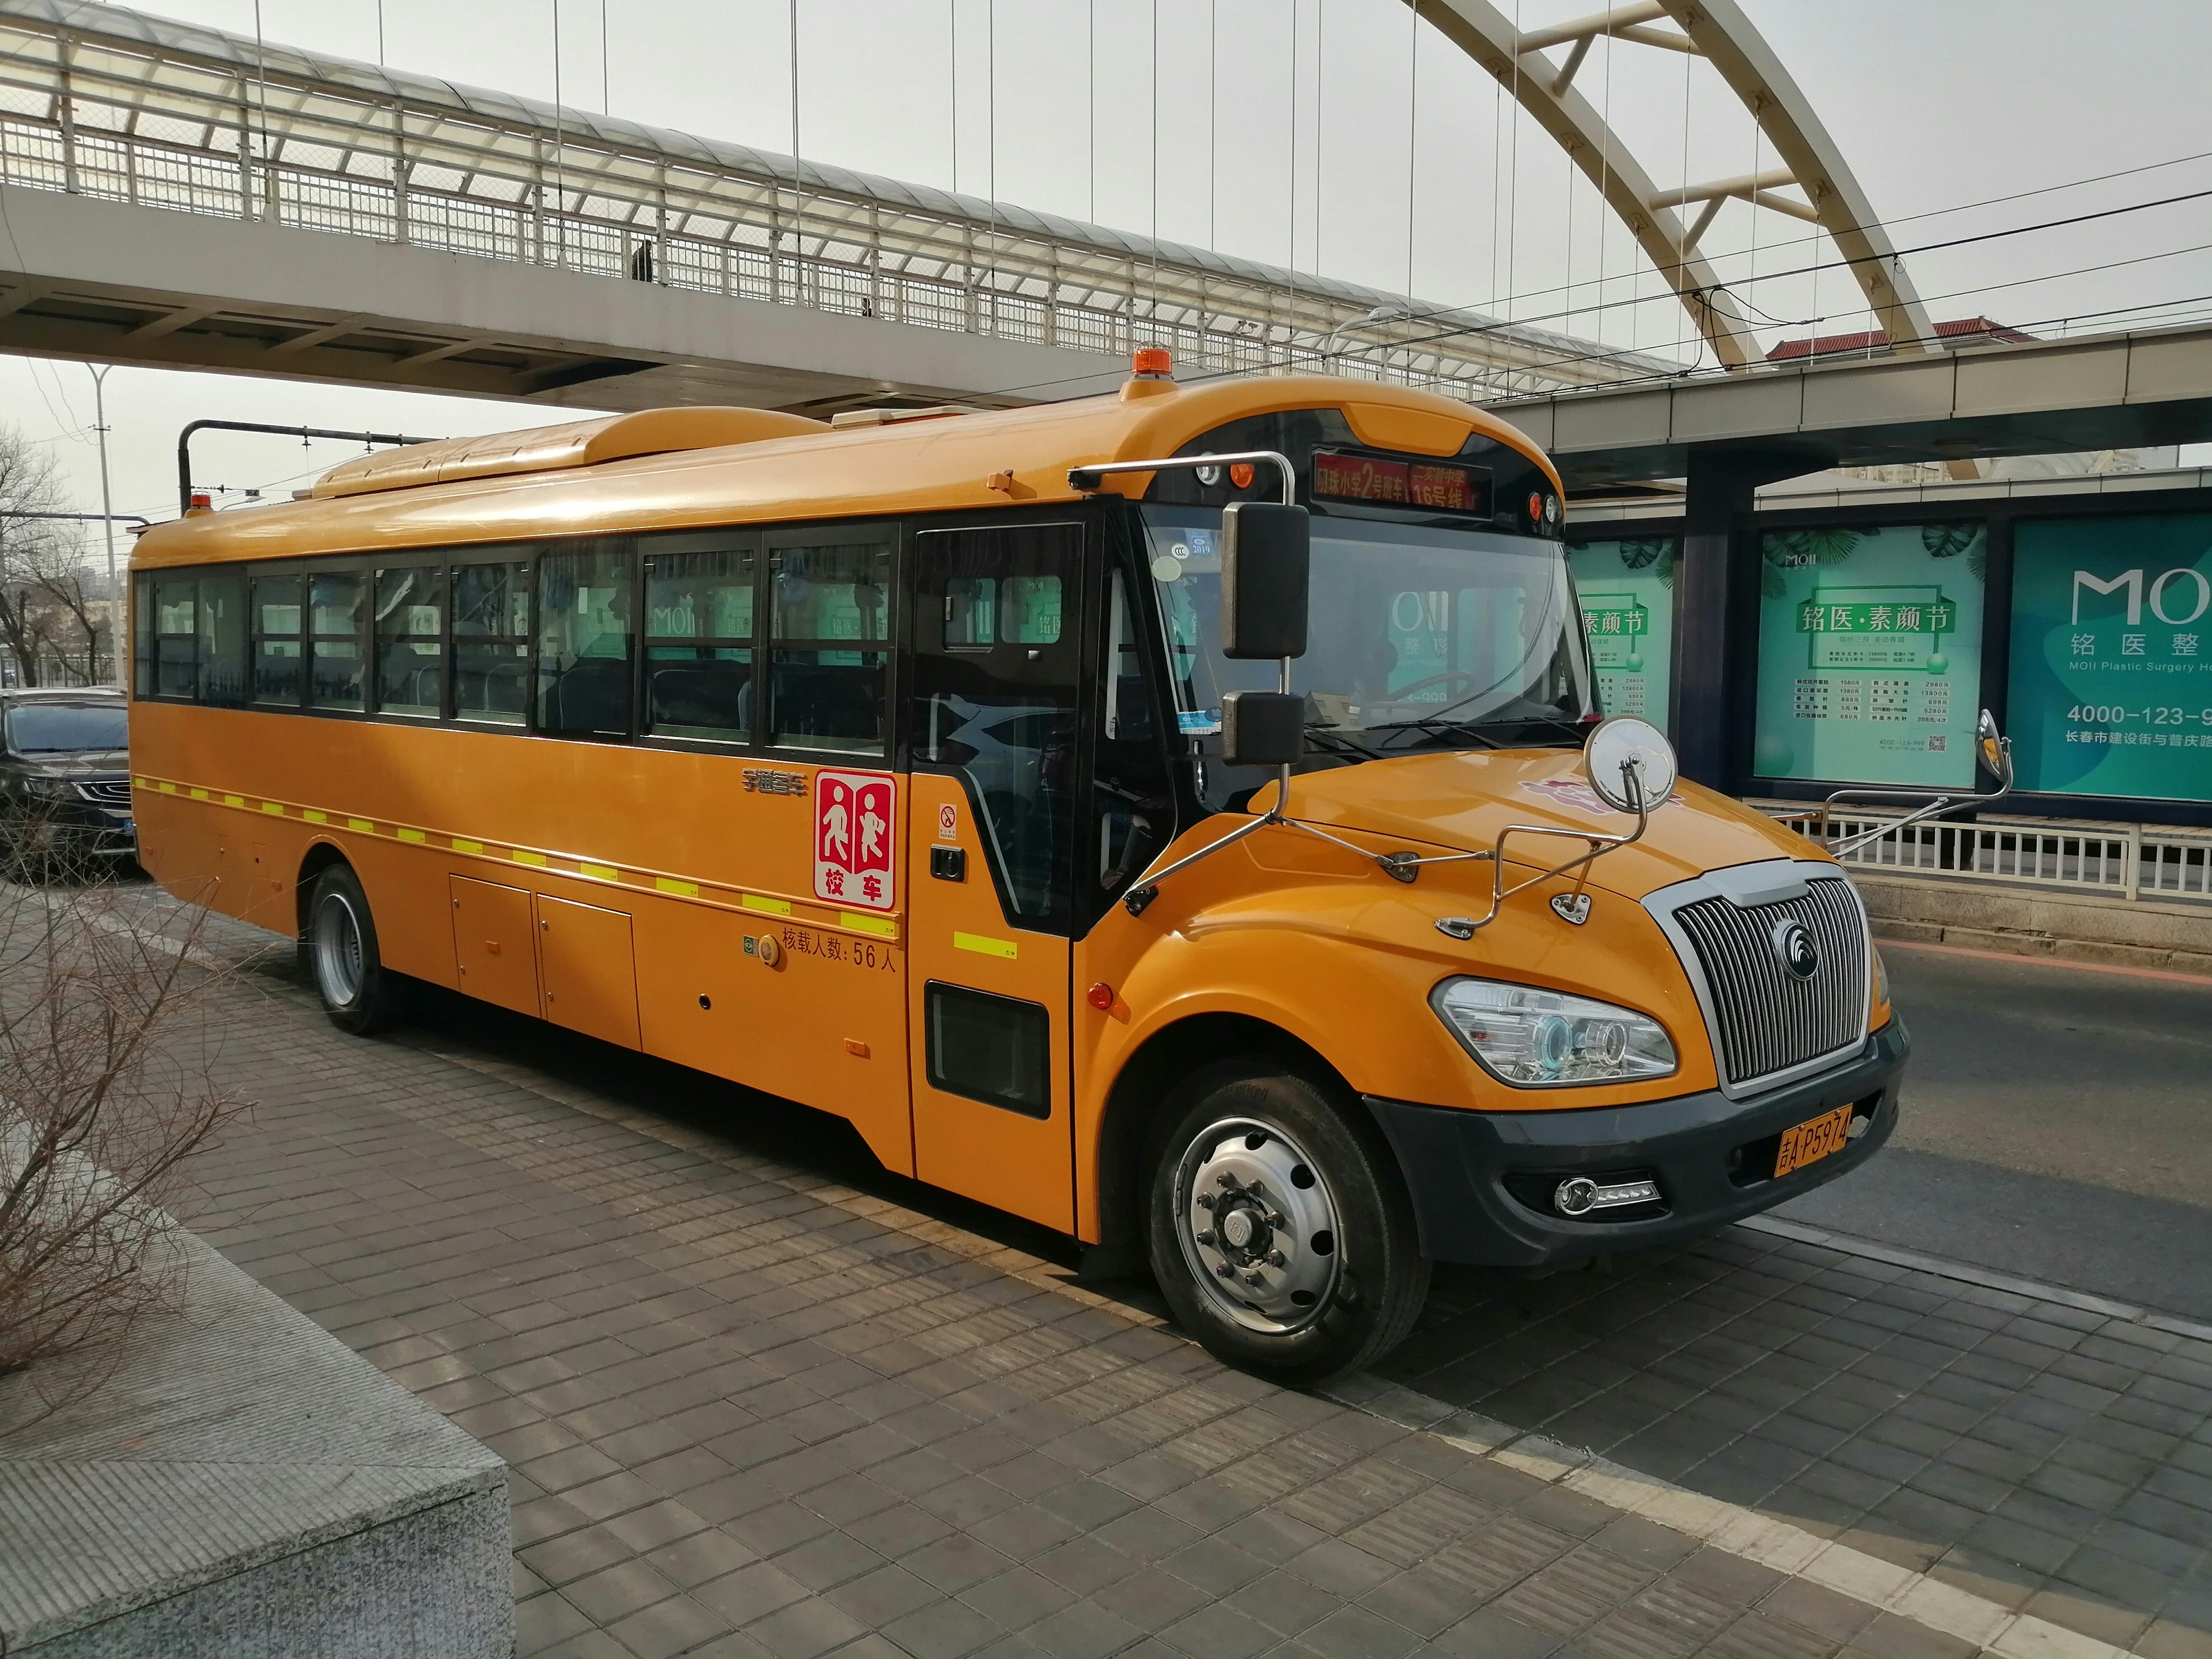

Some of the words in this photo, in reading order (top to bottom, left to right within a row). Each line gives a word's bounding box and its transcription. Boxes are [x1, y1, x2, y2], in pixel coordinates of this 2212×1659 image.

[1414, 484, 1463, 508] 16号线
[1192, 545, 1210, 554] 2019
[1583, 611, 1644, 634] 素颜节
[1802, 605, 1951, 632] 铭医·素颜节
[2070, 632, 2199, 656] 铭医整
[2102, 662, 2142, 671] Plastic
[2146, 662, 2194, 673] Surgery
[2067, 705, 2212, 726] 4000-123-9
[741, 768, 805, 795] 宇通客车
[826, 868, 882, 901] 校车
